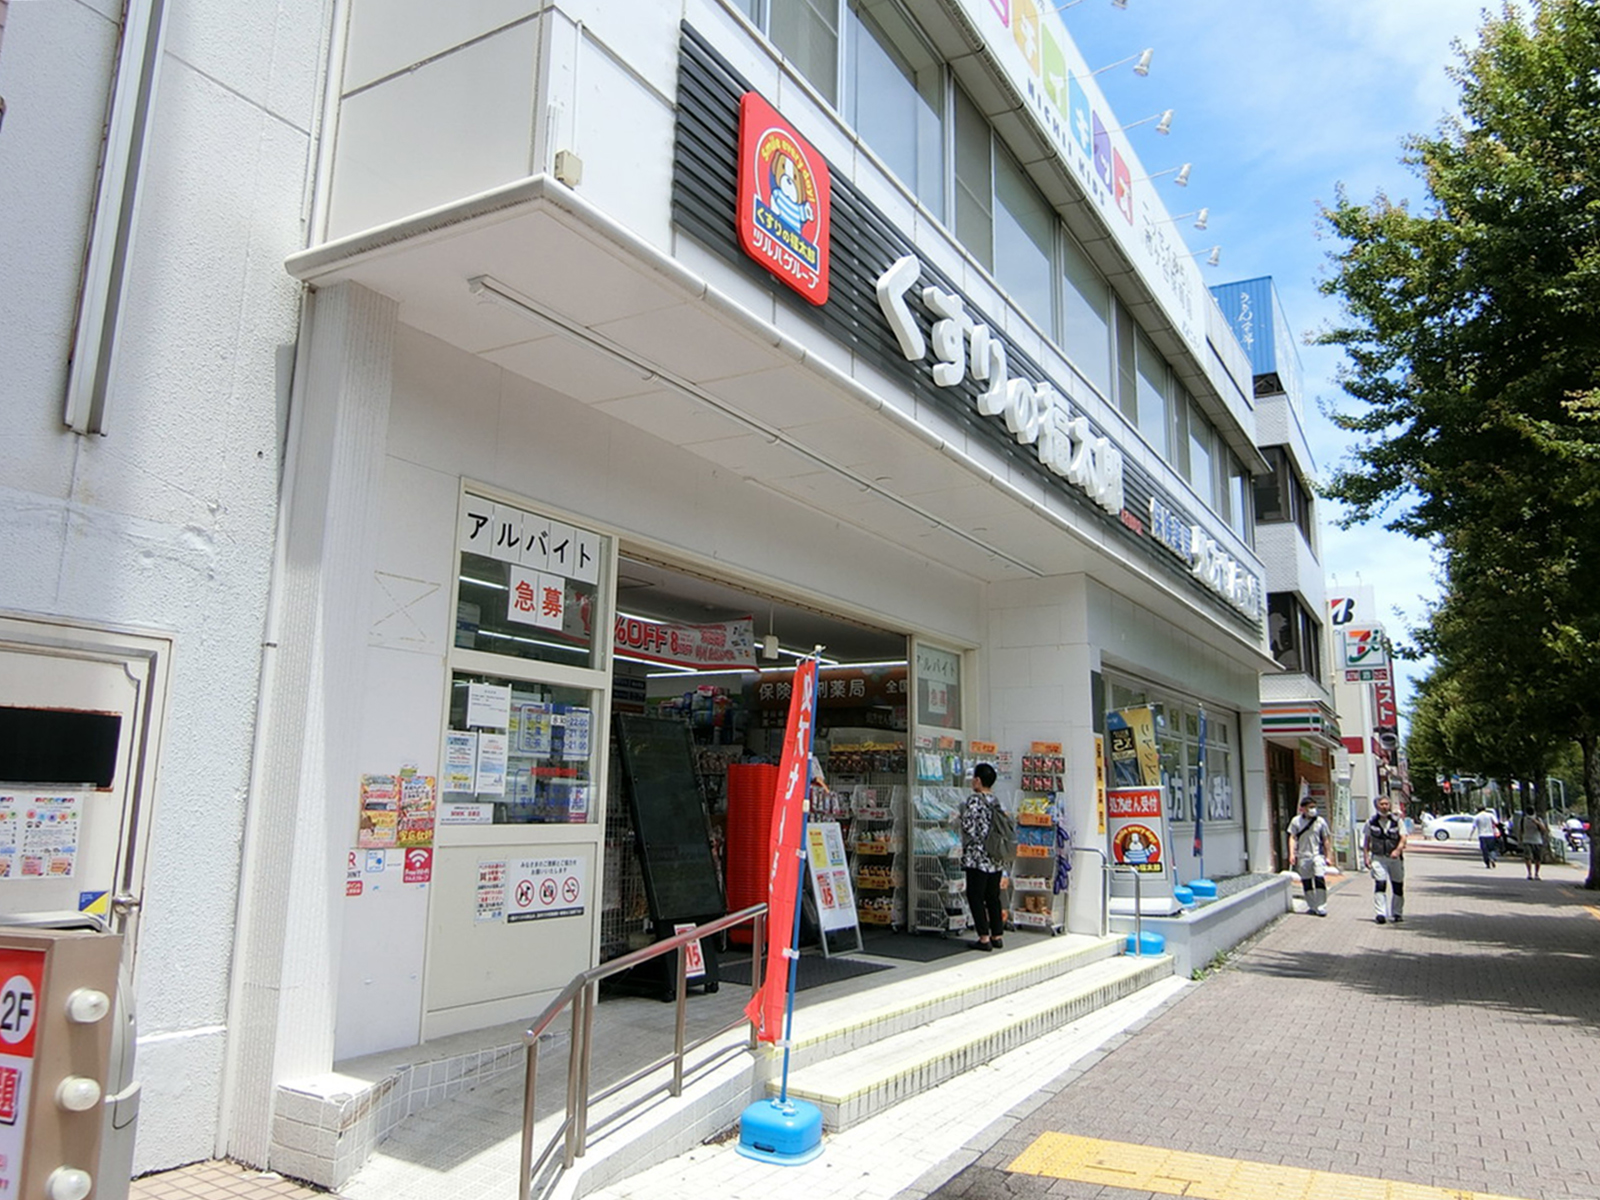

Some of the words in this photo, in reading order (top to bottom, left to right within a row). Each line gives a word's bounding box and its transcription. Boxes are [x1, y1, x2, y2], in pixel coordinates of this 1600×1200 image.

[1027, 78, 1073, 157] NICHII
[753, 228, 820, 290] ツルハグループ
[757, 206, 817, 265] くすりの福太郎
[877, 253, 1125, 515] くすりの福太郎
[467, 512, 591, 568] アルバイト
[515, 580, 563, 618] 急募
[1, 990, 33, 1032] 2F
